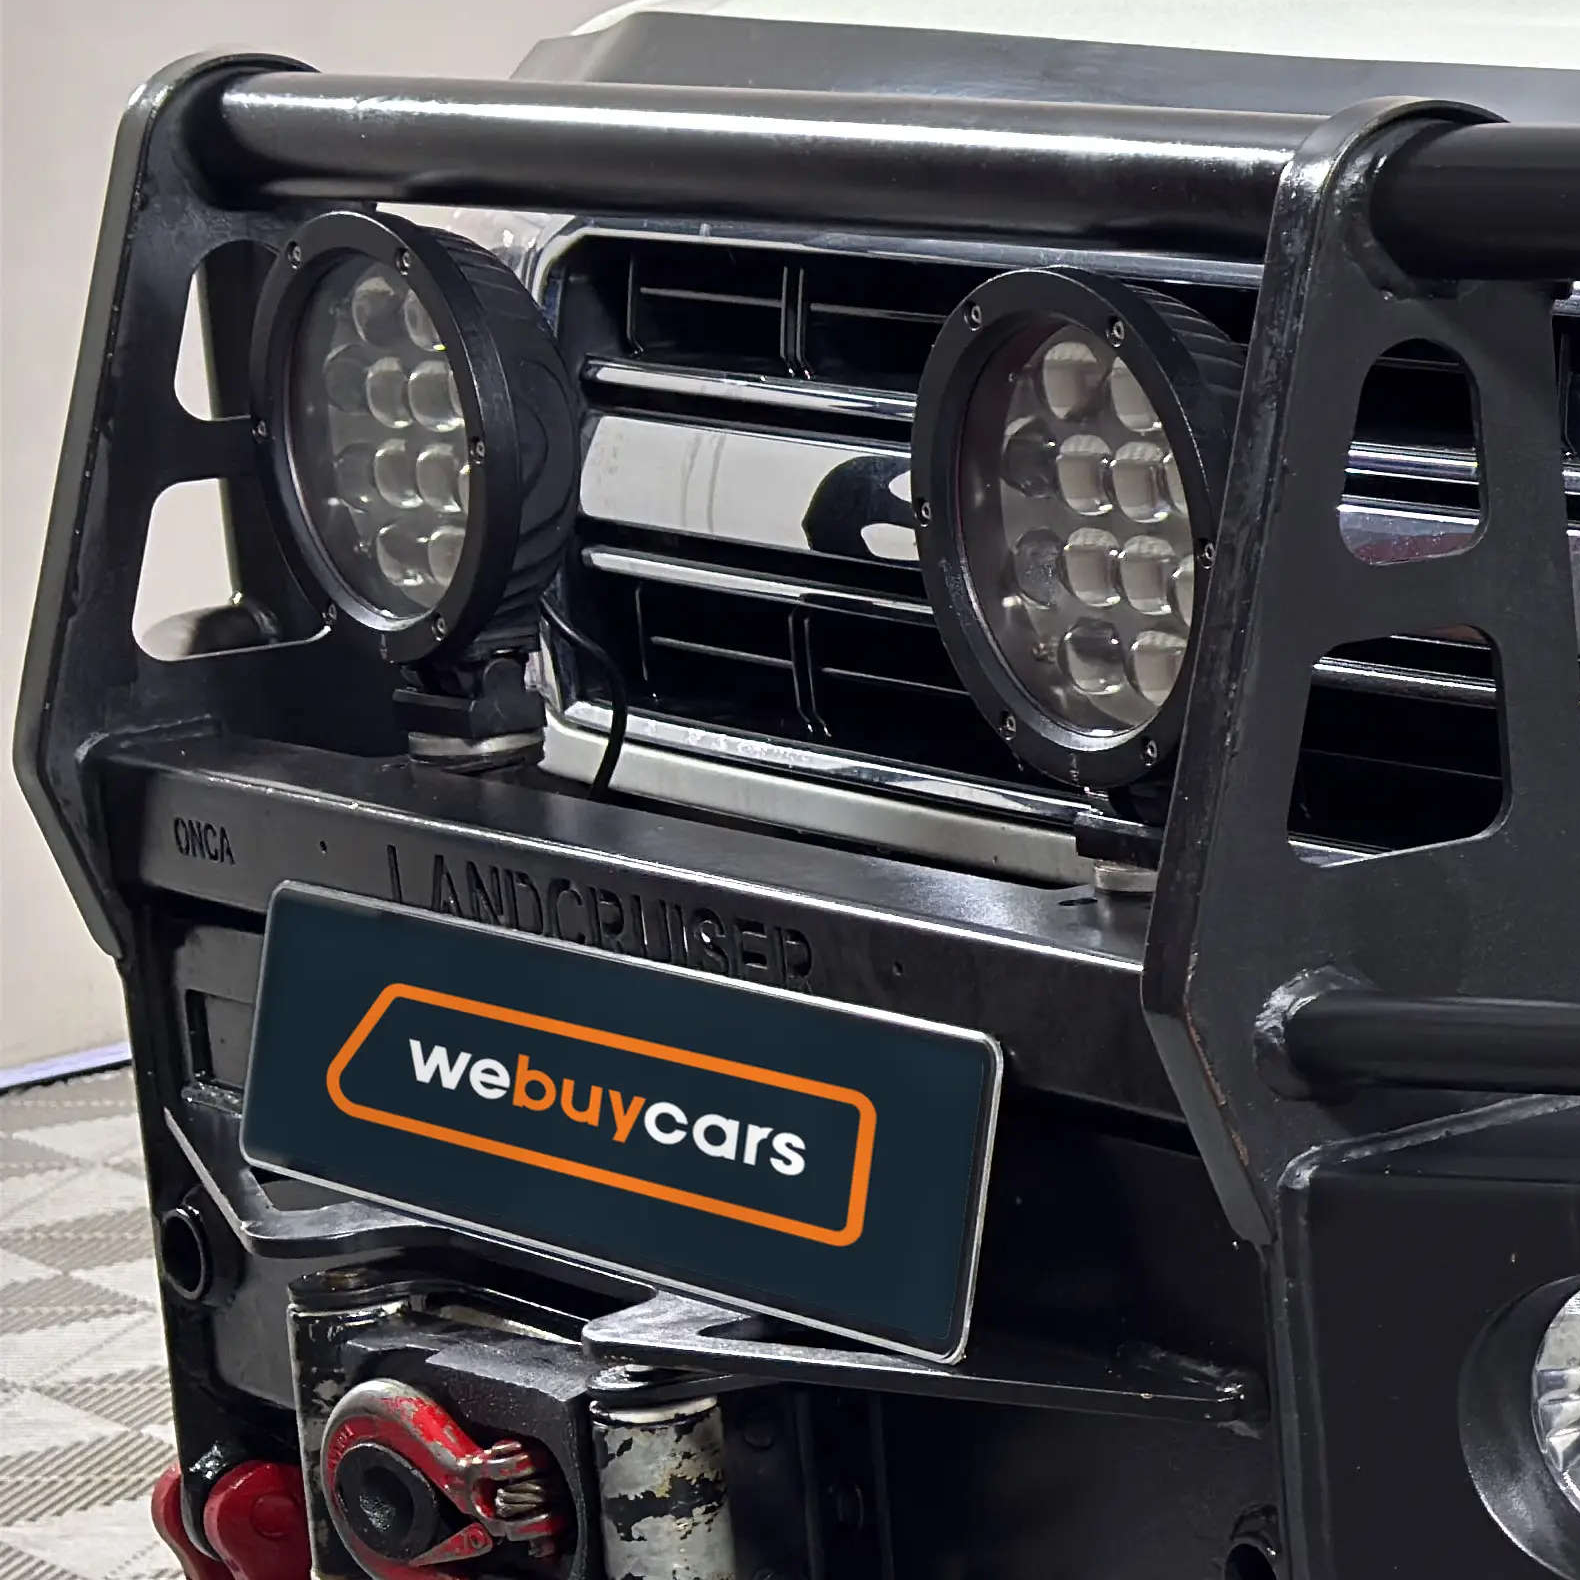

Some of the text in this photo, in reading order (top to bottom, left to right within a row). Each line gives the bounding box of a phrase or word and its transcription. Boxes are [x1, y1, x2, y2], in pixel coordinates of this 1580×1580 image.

[172, 818, 236, 866] ONCA
[385, 843, 814, 994] LANDCRUISER
[408, 1038, 807, 1177] webuycars
